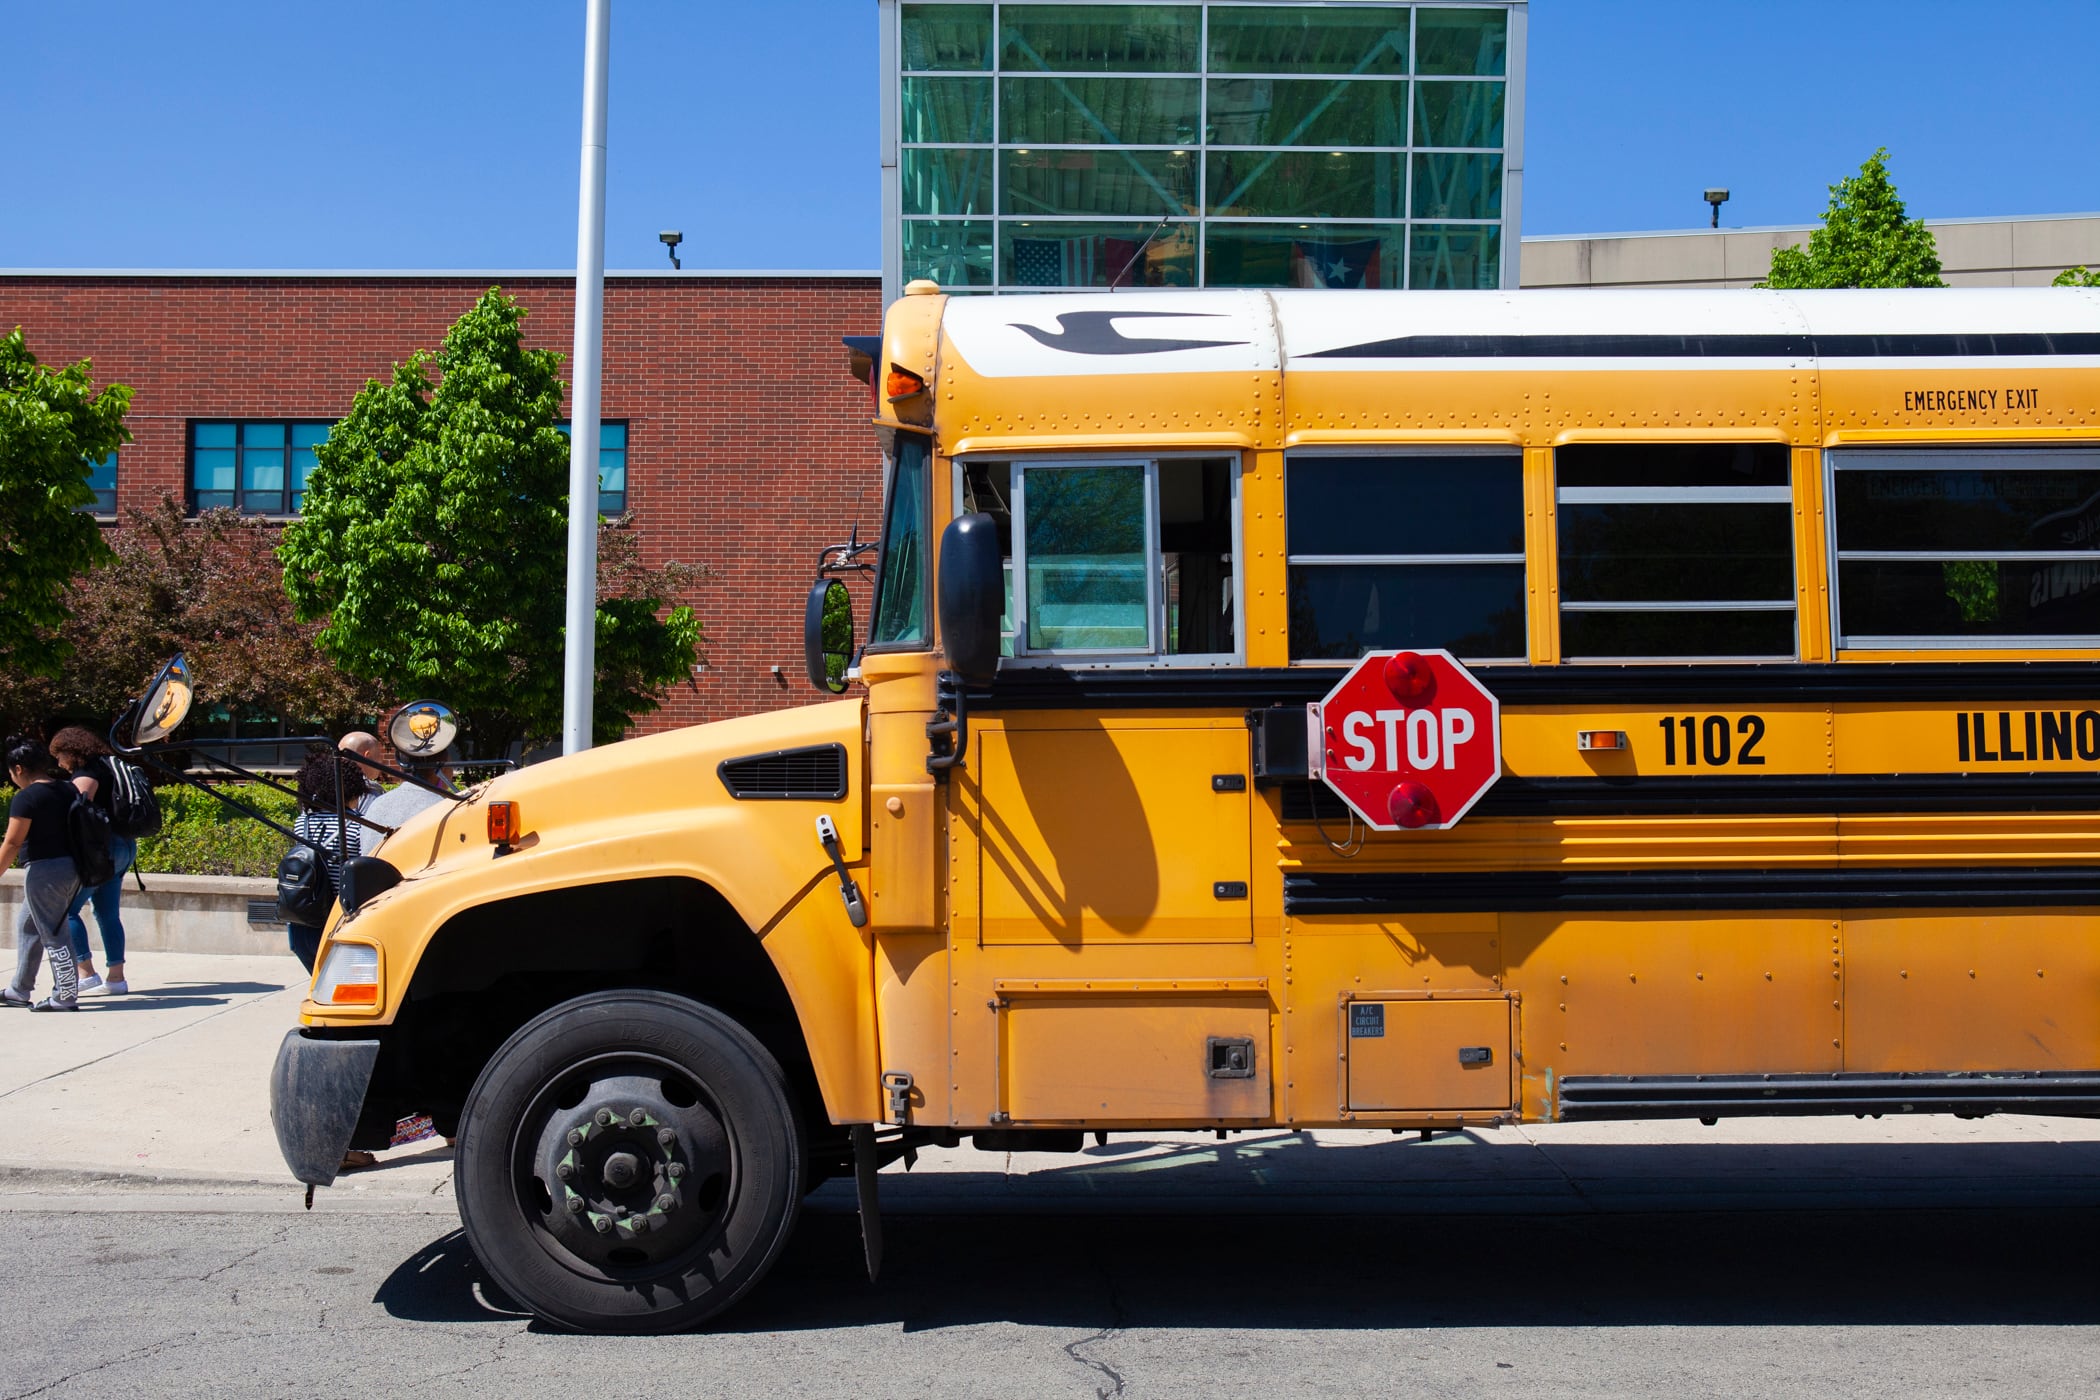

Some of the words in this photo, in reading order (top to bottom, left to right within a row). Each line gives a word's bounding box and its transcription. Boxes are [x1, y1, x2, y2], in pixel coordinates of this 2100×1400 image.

[1904, 390, 1998, 411] EMERGENCY
[2006, 388, 2039, 409] EXIT
[1343, 707, 1475, 772] STOP
[1659, 714, 1766, 766] 1102
[1957, 710, 2100, 763] ILLINO
[48, 945, 78, 1001] PINK
[1355, 1016, 1379, 1026] CIRCUIT
[1360, 1006, 1374, 1016] A/C
[1352, 1026, 1384, 1036] BREAKERS
